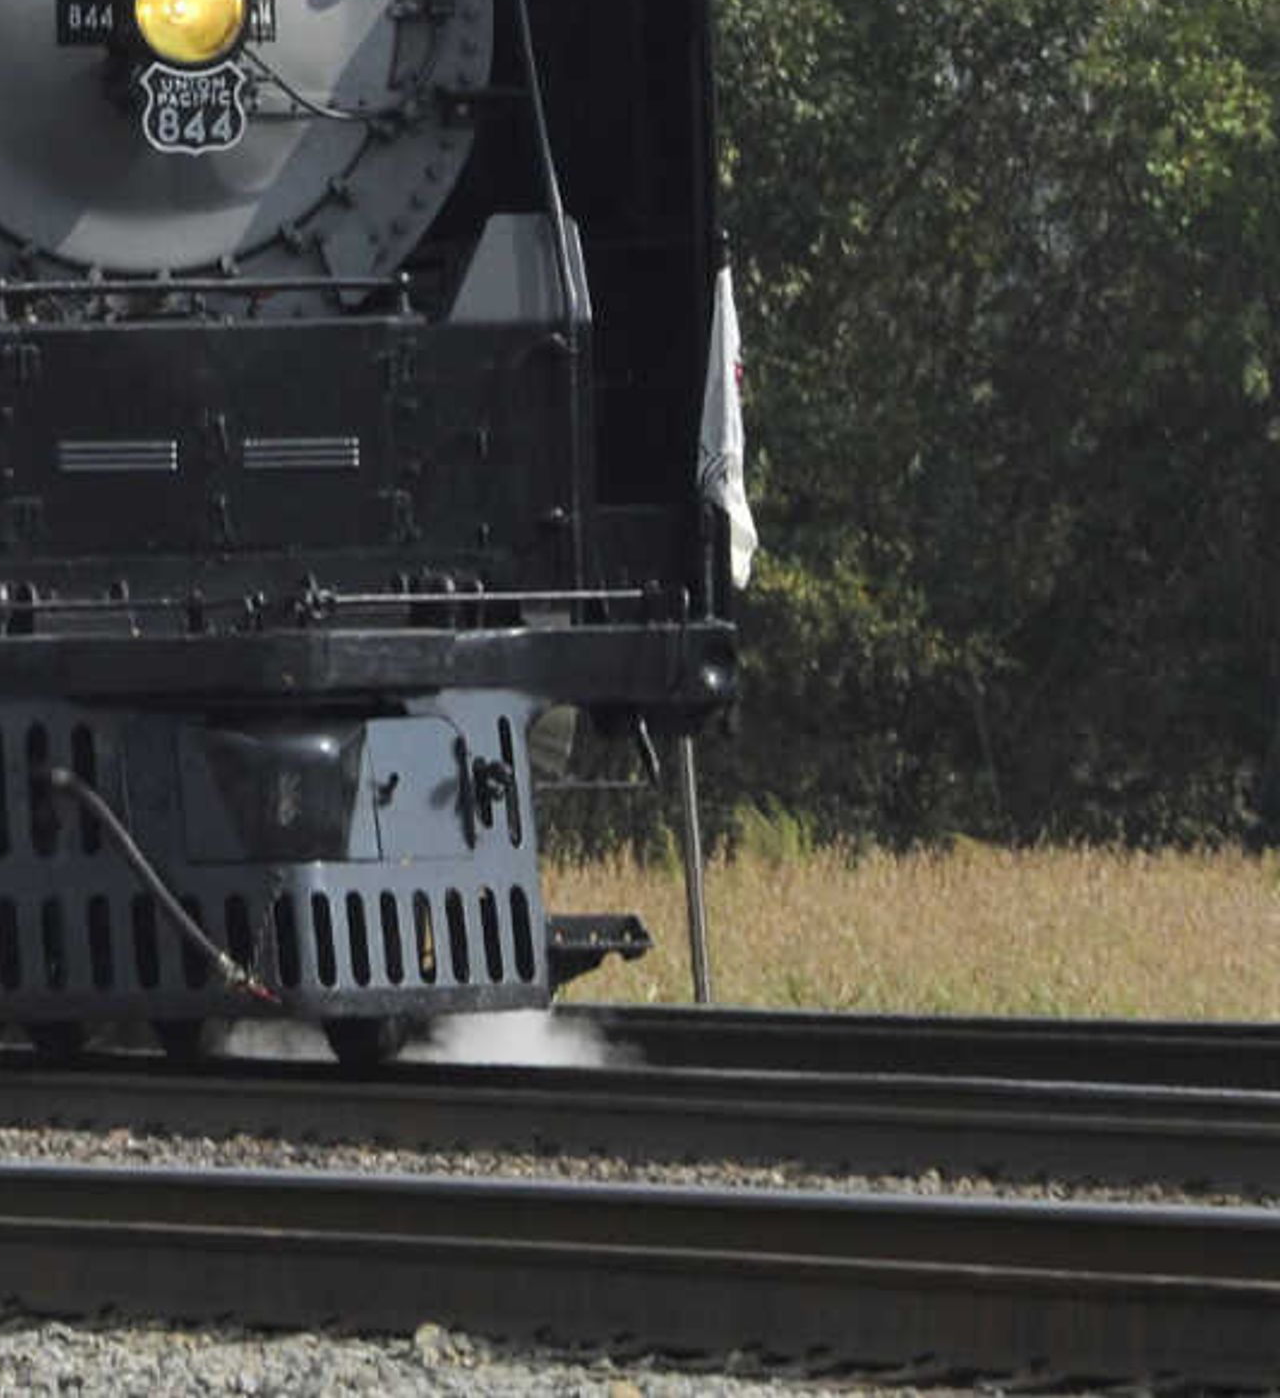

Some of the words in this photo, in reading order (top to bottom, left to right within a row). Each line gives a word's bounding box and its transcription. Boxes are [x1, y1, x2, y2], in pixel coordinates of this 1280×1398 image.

[160, 76, 226, 92] UNION
[157, 91, 231, 108] PACIFIC
[159, 107, 232, 142] 844
